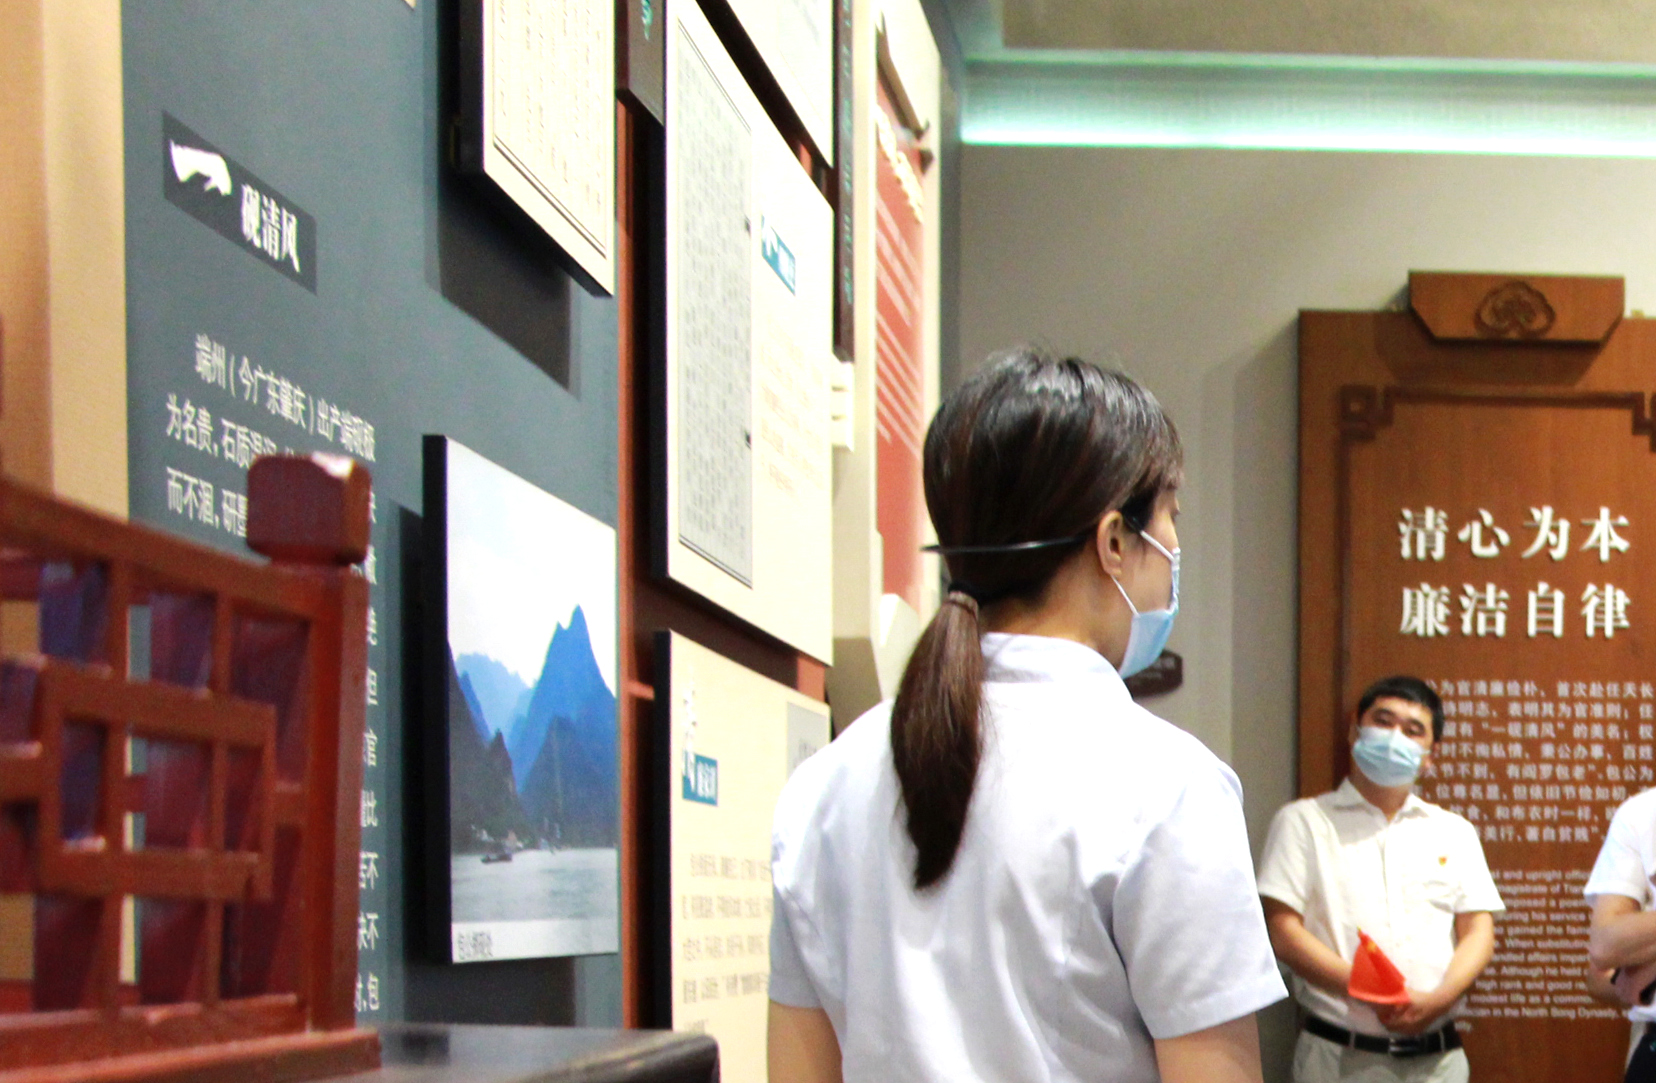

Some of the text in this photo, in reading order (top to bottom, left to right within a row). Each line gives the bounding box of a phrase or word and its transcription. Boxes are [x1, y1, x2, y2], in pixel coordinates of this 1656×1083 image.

[1397, 504, 1632, 562] 清心为本
[1399, 580, 1632, 639] 廉洁自律
